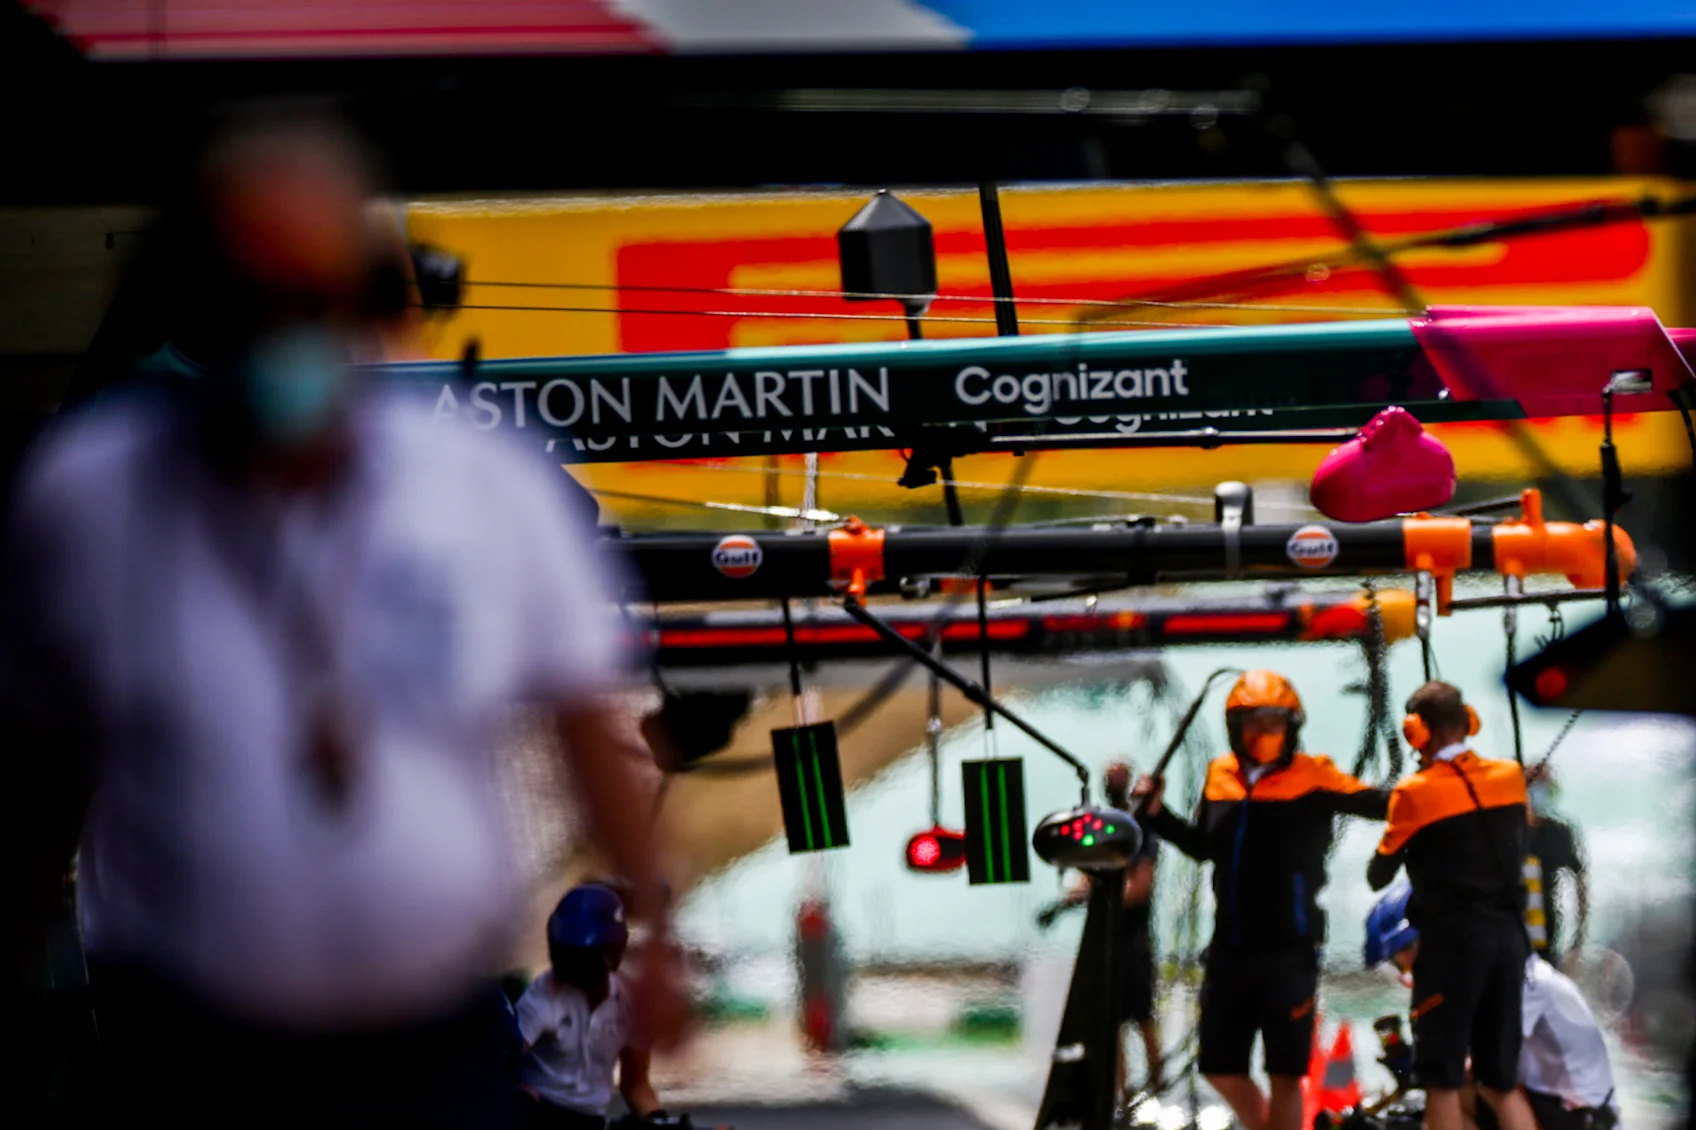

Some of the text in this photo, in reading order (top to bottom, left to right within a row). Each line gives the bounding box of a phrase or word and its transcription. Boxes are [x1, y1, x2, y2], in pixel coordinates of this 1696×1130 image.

[433, 367, 889, 431] ASTON MARTIN
[955, 359, 1189, 414] Cognizant
[715, 551, 759, 566] Gulf
[1290, 542, 1334, 556] Gulf
